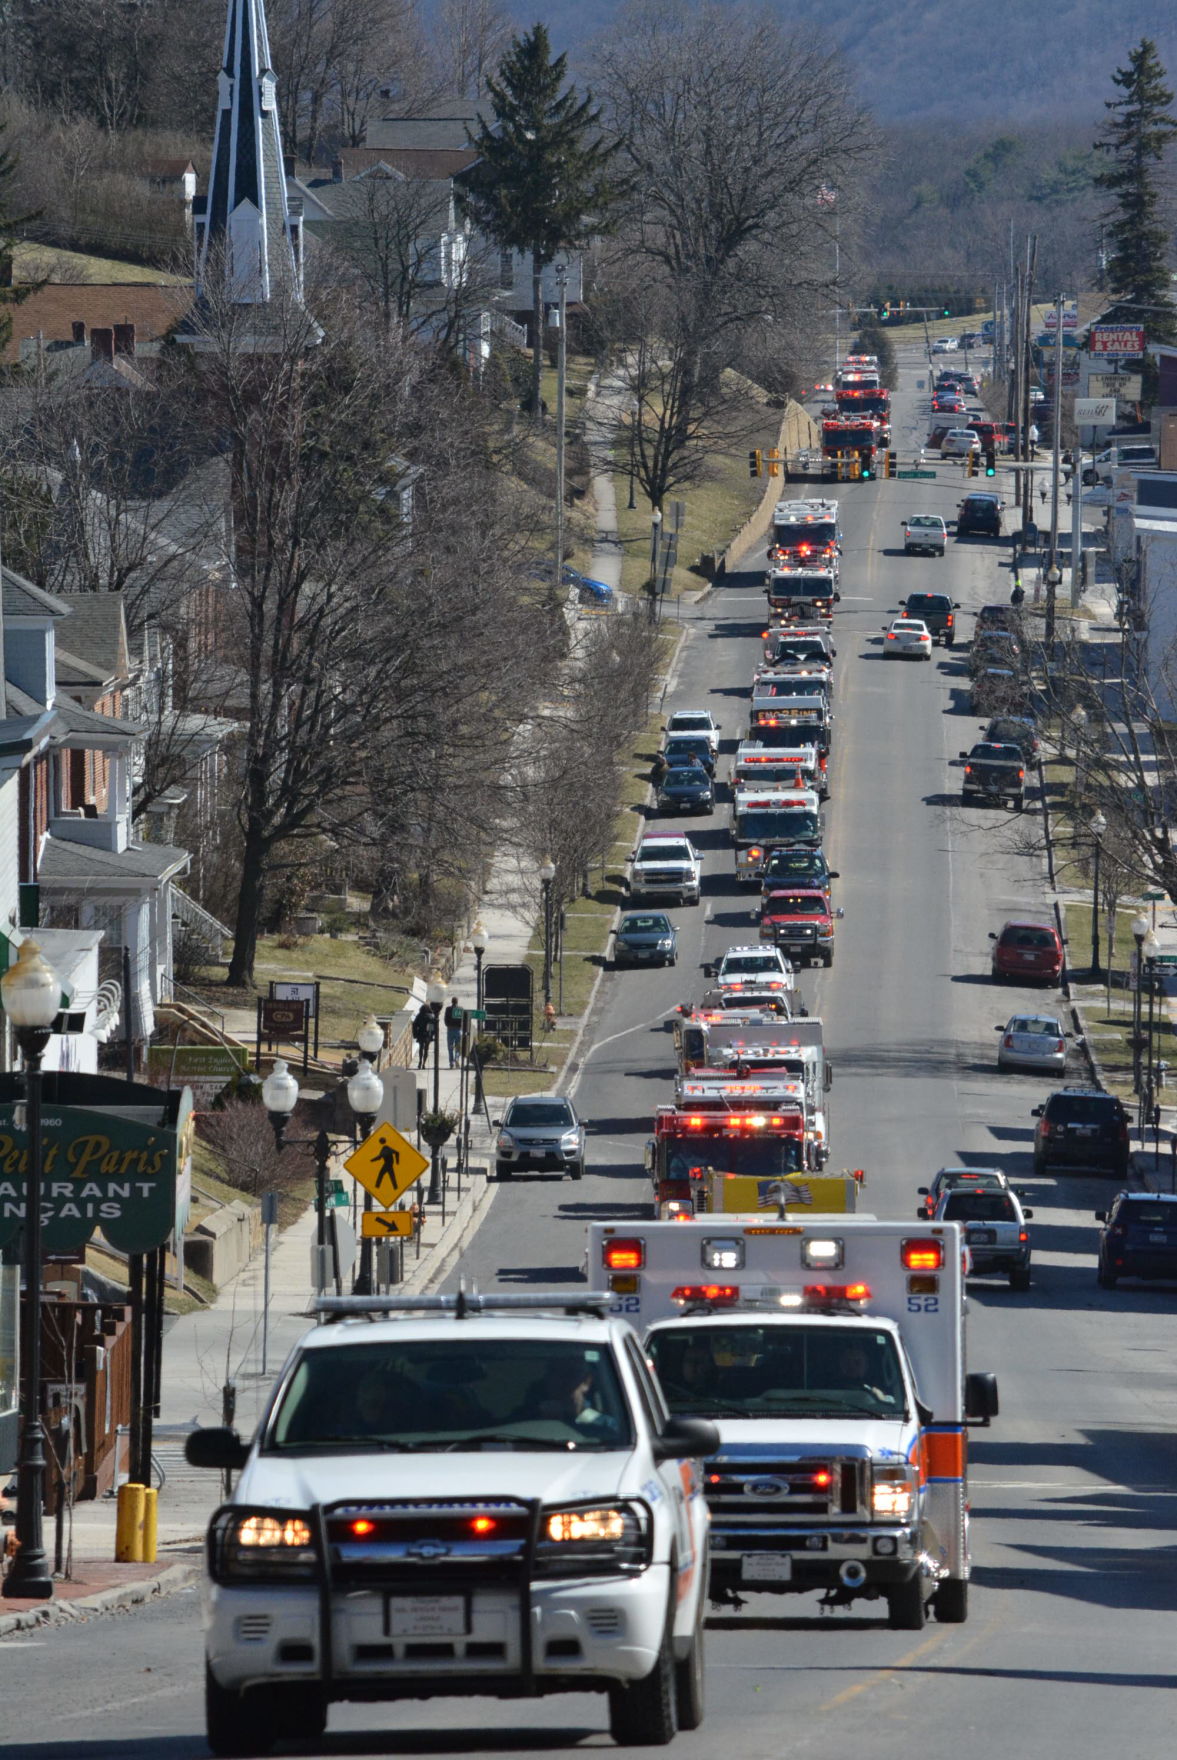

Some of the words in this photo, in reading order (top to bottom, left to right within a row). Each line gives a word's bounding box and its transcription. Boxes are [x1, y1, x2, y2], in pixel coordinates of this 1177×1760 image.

[1095, 332, 1139, 341] RENTAL
[1095, 341, 1103, 350] &
[1107, 341, 1140, 350] SALES
[67, 1134, 168, 1178] Paris
[609, 1296, 640, 1313] 52
[907, 1297, 940, 1313] 52
